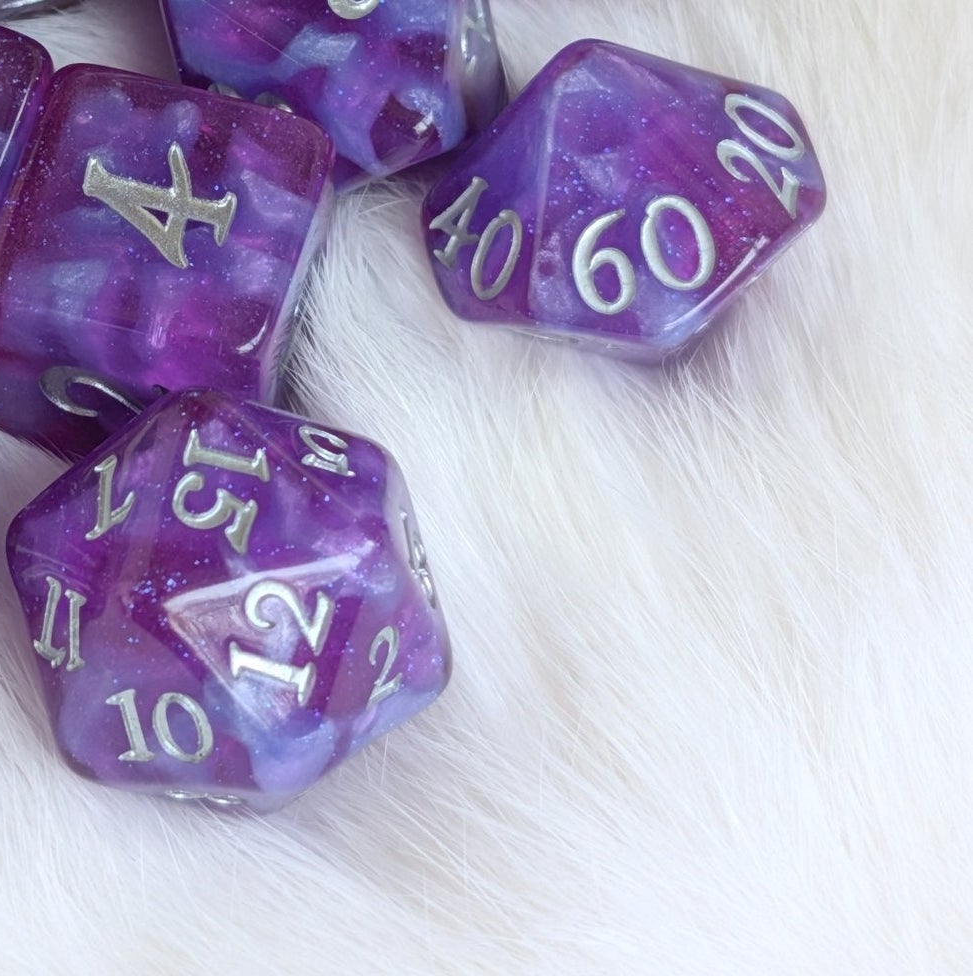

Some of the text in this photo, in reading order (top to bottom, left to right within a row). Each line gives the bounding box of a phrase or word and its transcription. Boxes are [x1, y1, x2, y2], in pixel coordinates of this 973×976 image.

[82, 141, 238, 269] 4
[717, 94, 806, 219] 20
[429, 176, 523, 301] 40
[572, 195, 716, 315] 60
[172, 428, 270, 554] 15
[229, 579, 329, 707] 12
[367, 625, 403, 707] 2
[105, 688, 215, 763] 10
